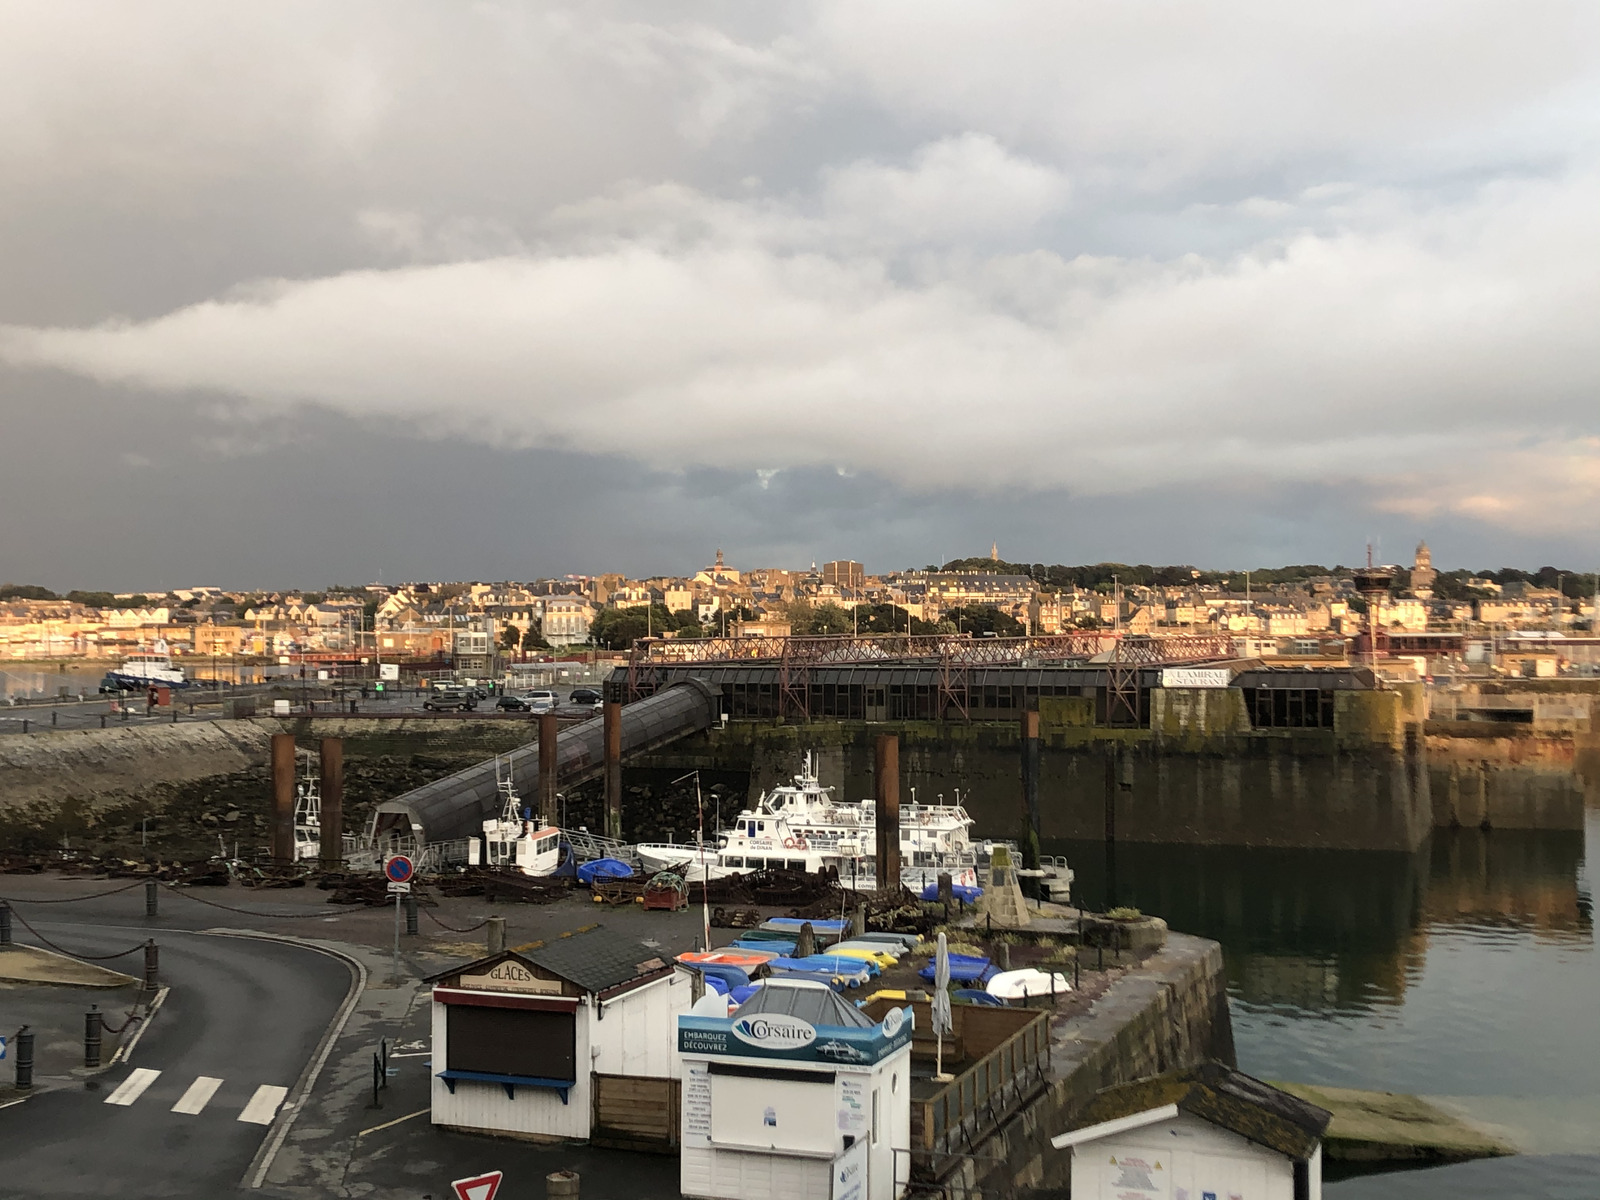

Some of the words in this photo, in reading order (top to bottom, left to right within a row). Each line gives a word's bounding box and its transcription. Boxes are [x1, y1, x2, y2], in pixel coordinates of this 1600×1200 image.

[490, 965, 531, 982] GLACES
[683, 1031, 727, 1041] EMBARQUEZ
[751, 1019, 812, 1041] Corsaire
[683, 1041, 728, 1051] DÉCOUVREZ
